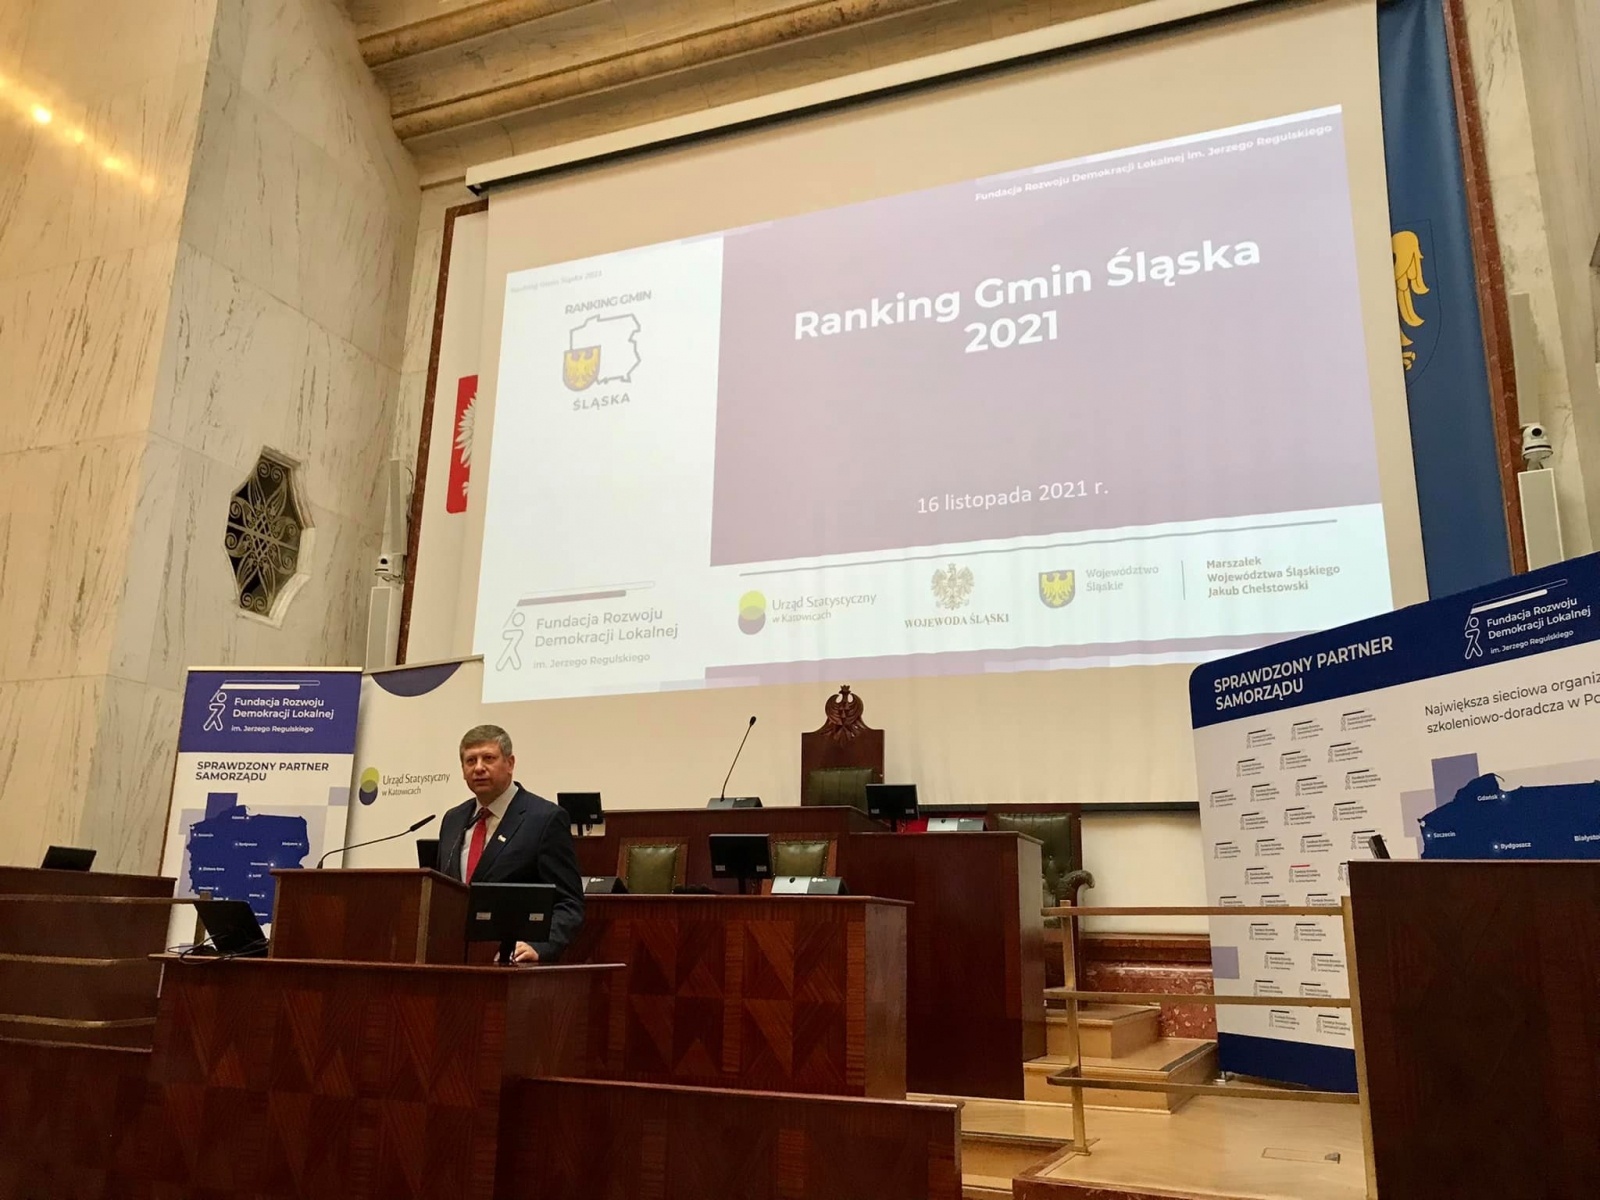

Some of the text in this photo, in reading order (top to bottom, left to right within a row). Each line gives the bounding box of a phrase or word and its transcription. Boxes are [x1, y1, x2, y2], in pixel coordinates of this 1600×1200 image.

[975, 124, 1333, 201] Fundacja Rozwoju Demokracji Lokalnej im. Jerzego Regulskiego
[794, 239, 1260, 340] Ranking Gmin Śląska
[564, 290, 652, 315] RANKING GMIN
[964, 310, 1058, 354] 2021
[573, 392, 631, 411] ŚLĄSKA
[918, 480, 1109, 514] 16 listopada 2021 r.
[1086, 564, 1159, 579] Województwo
[1206, 556, 1262, 569] Marszałek
[1207, 563, 1341, 583] Województwa Śląskiego
[1086, 580, 1124, 592] Śląskie
[1207, 580, 1309, 598] Jakub Chełstowski
[771, 593, 877, 612] Urząd Statystyczny
[536, 608, 663, 630] Fundacja Rozwoju
[781, 610, 832, 623] Katowicach
[904, 613, 1009, 629] WOJEWODA ŚLĄSKI
[1487, 597, 1578, 628] Fundacja Rozwoju
[1488, 605, 1591, 639] Demokracji Lokalnej
[534, 624, 679, 648] Demokracji Lokalnej
[1502, 640, 1529, 652] Jerzego
[1530, 630, 1574, 646] Regulskiego
[533, 653, 650, 669] im. Jerzego Regulskiego
[1214, 636, 1393, 693] SPRAWDZONY PARTNER
[234, 697, 325, 708] Fundacja Rozwoju
[1215, 678, 1303, 711] SAMORZĄDU
[1425, 695, 1490, 716] Największa
[1492, 684, 1548, 704] sieciowa
[232, 708, 335, 720] Demokracji Lokalnej
[1427, 701, 1565, 734] szkoleniowo-doradcza
[1567, 698, 1580, 709] w
[243, 725, 271, 734] Jerzego
[271, 725, 315, 734] Regulskiego
[197, 761, 330, 772] SPRAWDZONY PARTNER
[195, 772, 267, 783] SAMORZĄDU
[382, 773, 451, 787] Urząd Statystyczny
[388, 786, 422, 796] Katowicach
